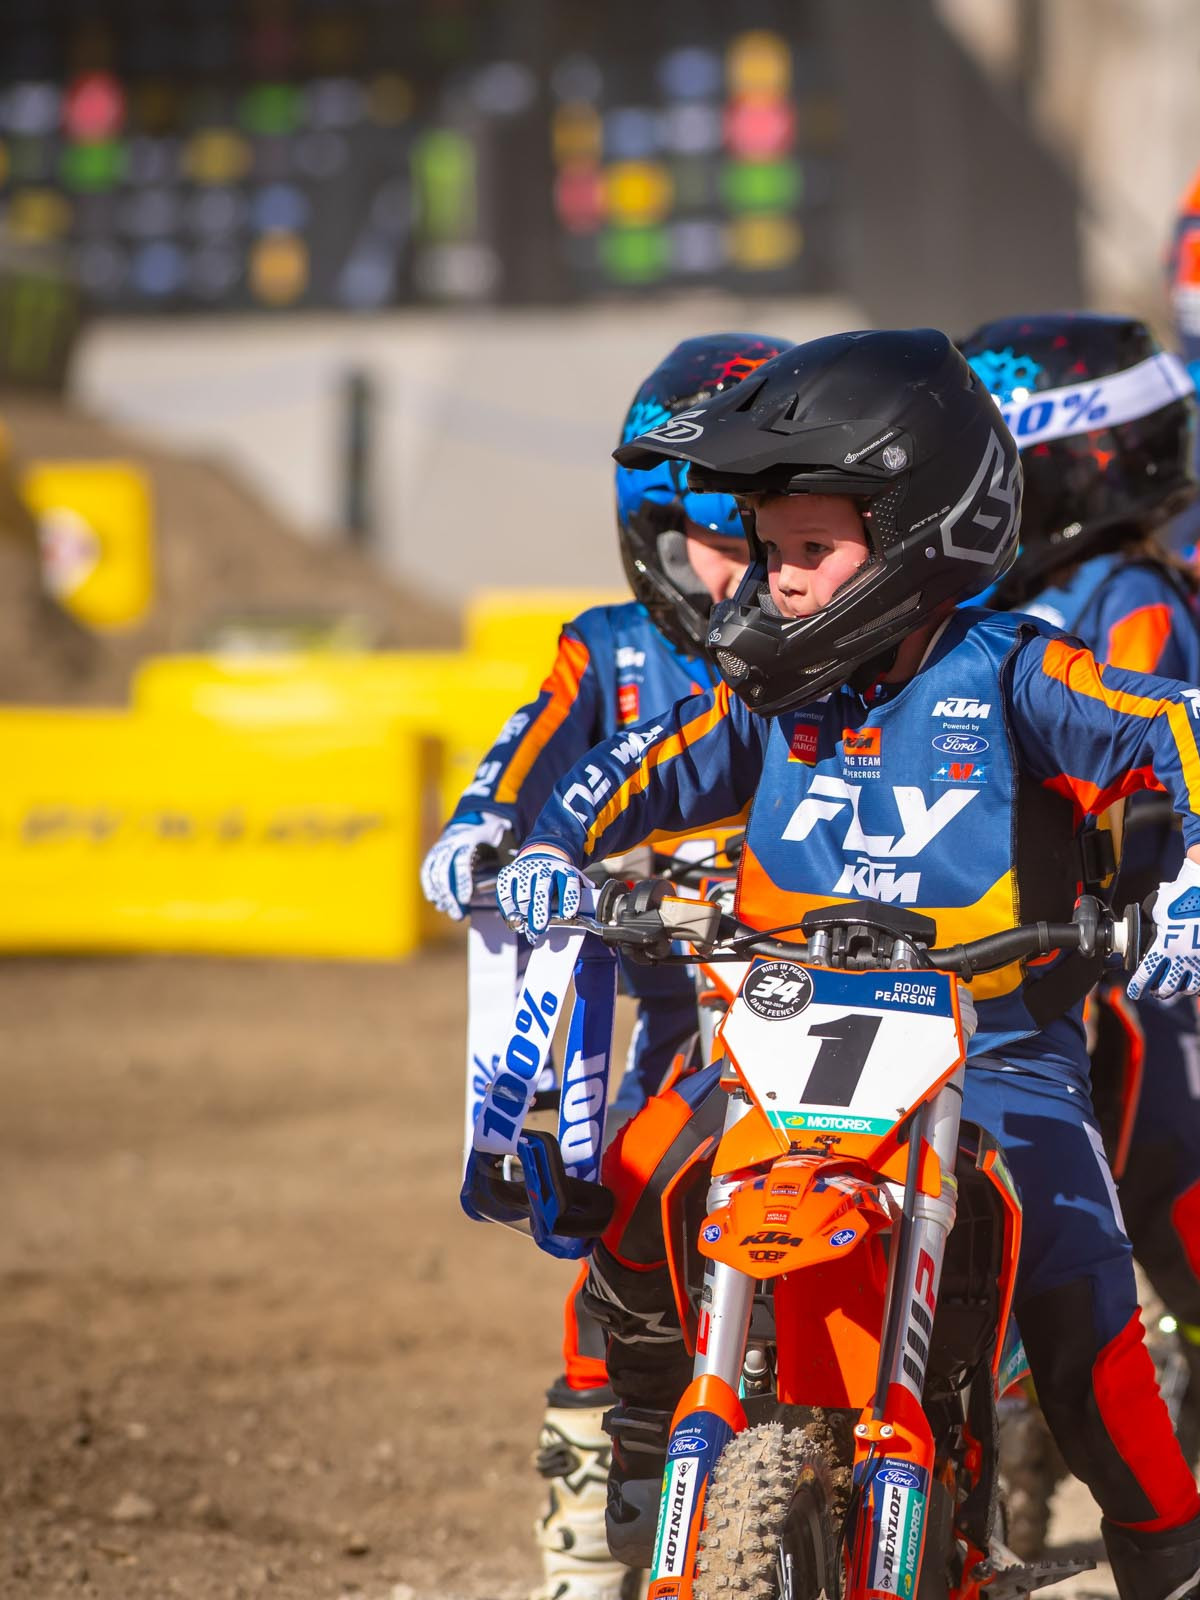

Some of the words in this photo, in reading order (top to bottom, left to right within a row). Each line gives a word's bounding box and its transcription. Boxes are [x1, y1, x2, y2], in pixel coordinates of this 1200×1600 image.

[1003, 386, 1108, 437] 0%
[931, 697, 991, 719] KTM
[942, 722, 970, 731] Powered
[971, 723, 979, 732] by
[942, 735, 978, 752] Ford
[857, 756, 881, 767] TEAM
[780, 774, 981, 859] FLY
[832, 856, 922, 904] KTM
[760, 963, 779, 974] RIDE
[779, 963, 789, 971] IN
[788, 963, 809, 982] PEACE
[750, 975, 805, 1003] 34
[875, 990, 936, 1007] PEARSON
[893, 982, 937, 997] BOONE
[750, 997, 768, 1014] DAVE
[766, 1006, 796, 1017] FEENEY
[482, 987, 559, 1142] 100%
[799, 1014, 883, 1108] 1
[806, 1115, 873, 1132] MOTOREX
[739, 1230, 803, 1248] KTM
[833, 1230, 854, 1246] Ford
[672, 1438, 698, 1454] Ford
[885, 1459, 908, 1469] Powered
[884, 1470, 913, 1487] Ford
[664, 1480, 687, 1573] DUNLOP
[883, 1486, 902, 1574] DUNLOP
[905, 1499, 923, 1573] MOTOREX
